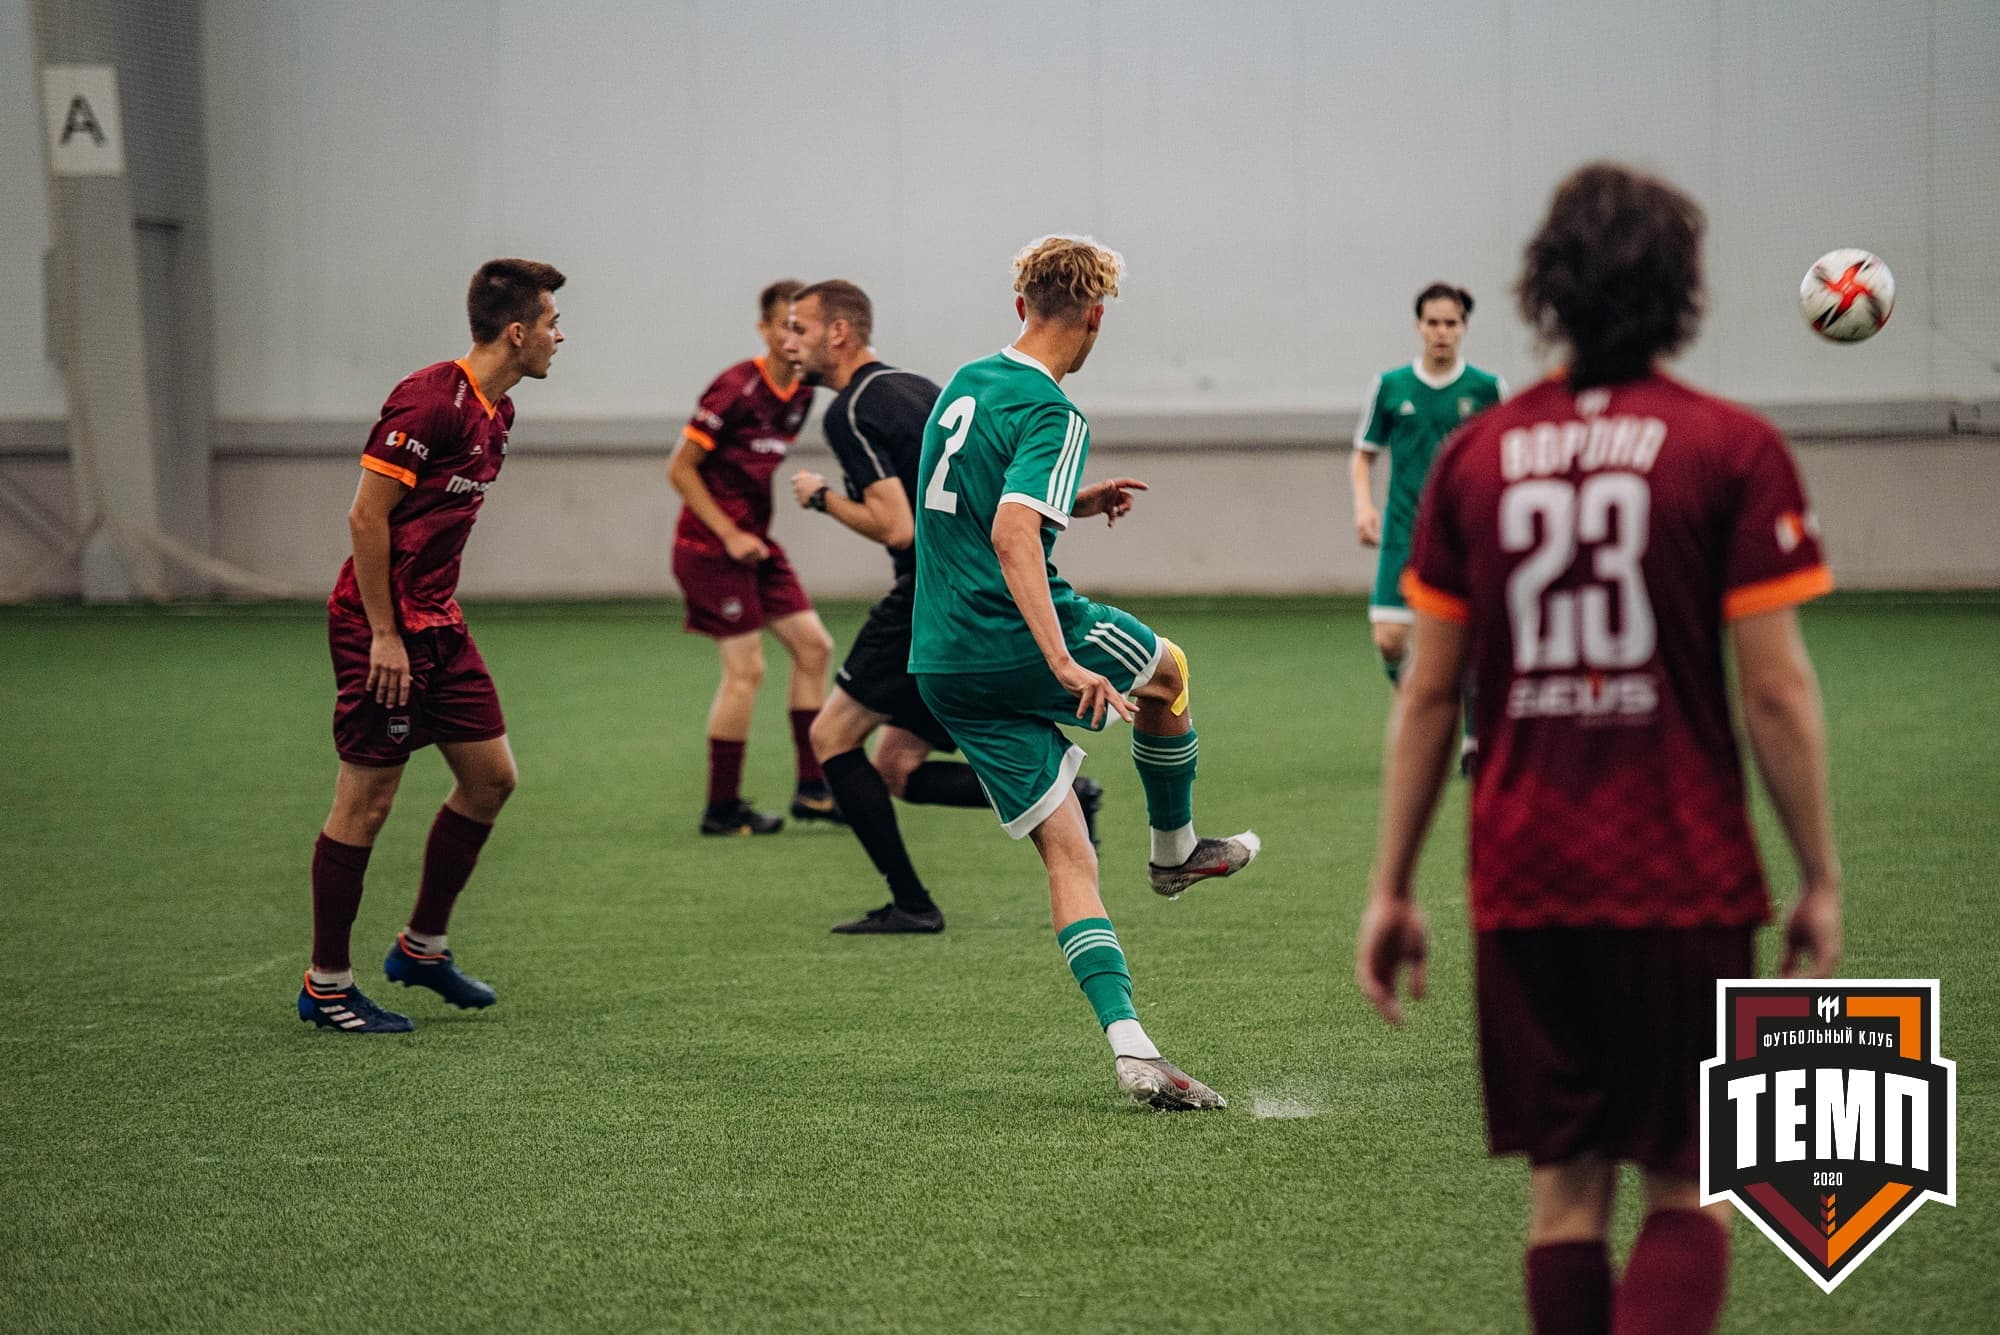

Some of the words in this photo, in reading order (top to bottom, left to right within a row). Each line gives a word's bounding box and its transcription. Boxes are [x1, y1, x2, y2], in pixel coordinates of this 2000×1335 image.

[60, 93, 105, 146] А
[924, 395, 976, 515] 2
[1500, 473, 1657, 672] 23
